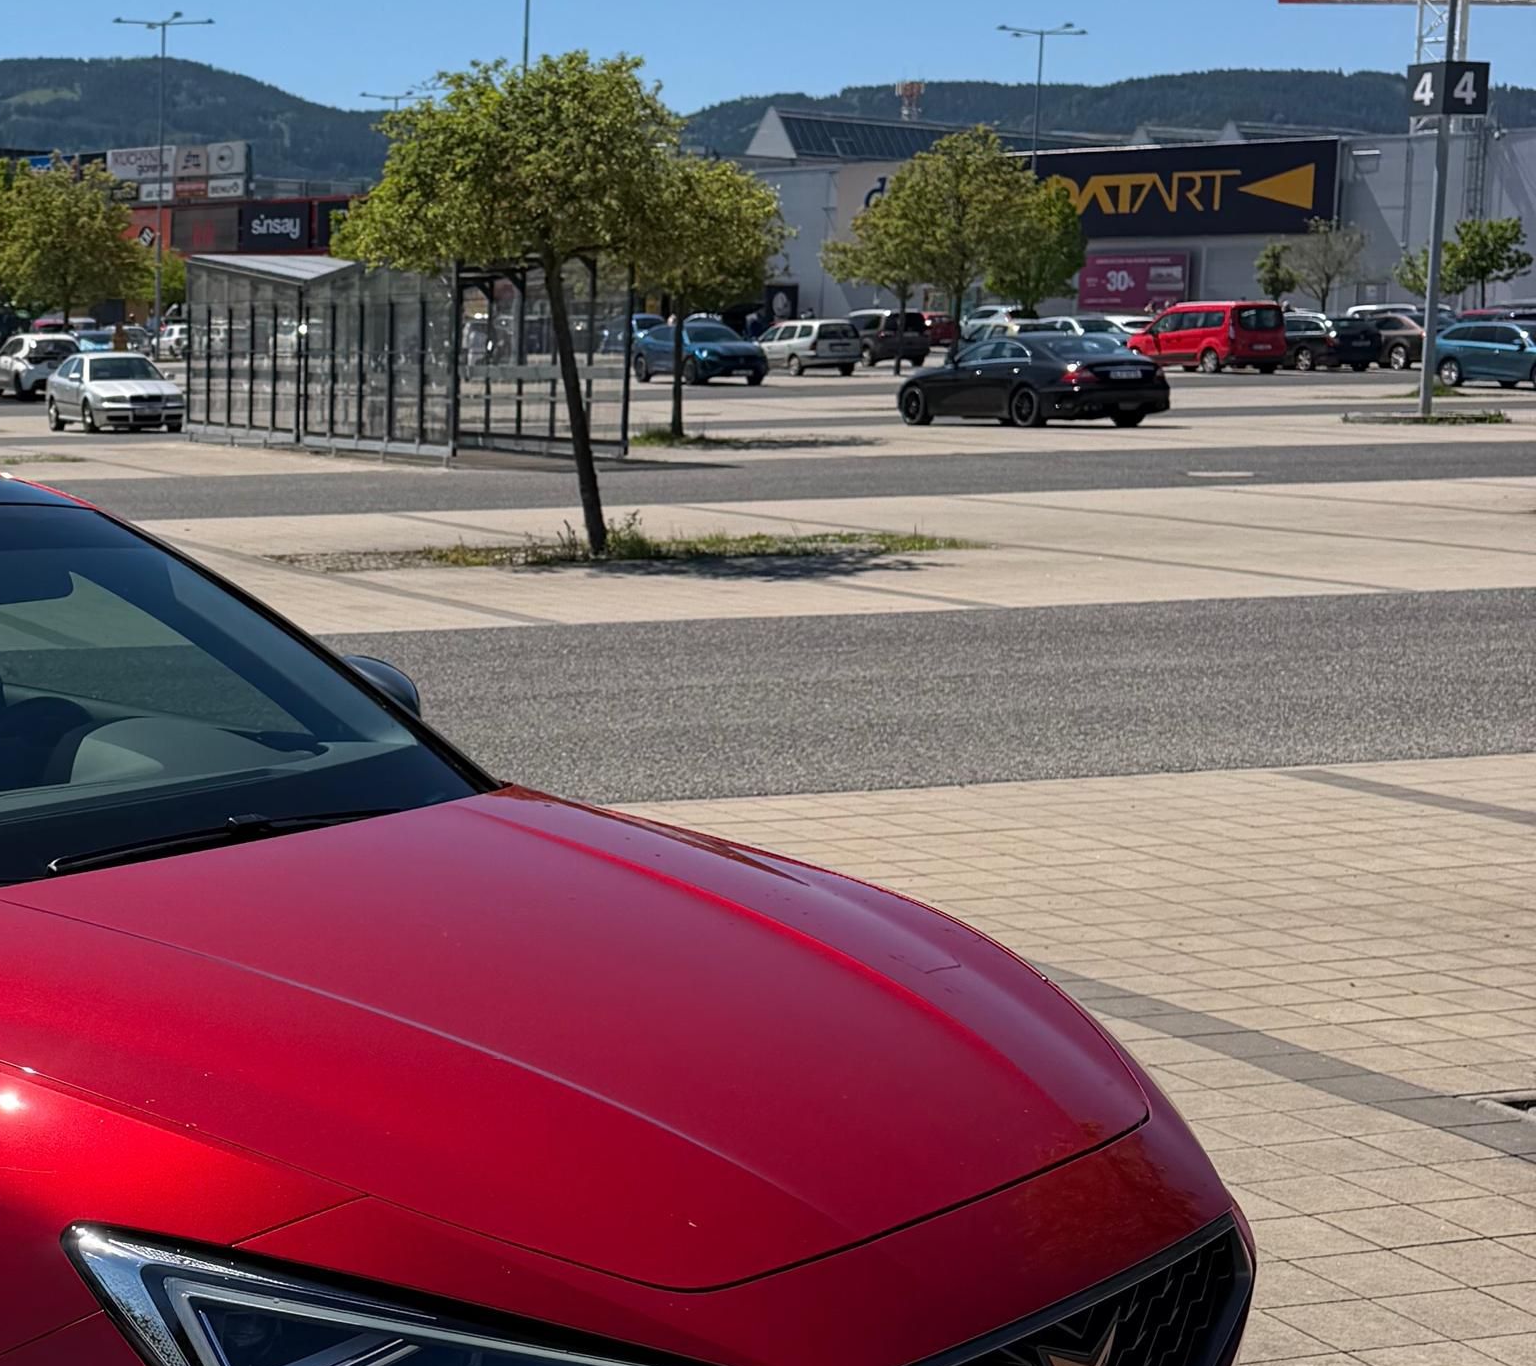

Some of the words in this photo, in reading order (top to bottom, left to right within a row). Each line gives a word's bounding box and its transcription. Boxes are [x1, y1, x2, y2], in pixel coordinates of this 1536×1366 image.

[1413, 71, 1435, 106] 4
[1453, 70, 1477, 105] 4
[250, 214, 301, 240] sinsay
